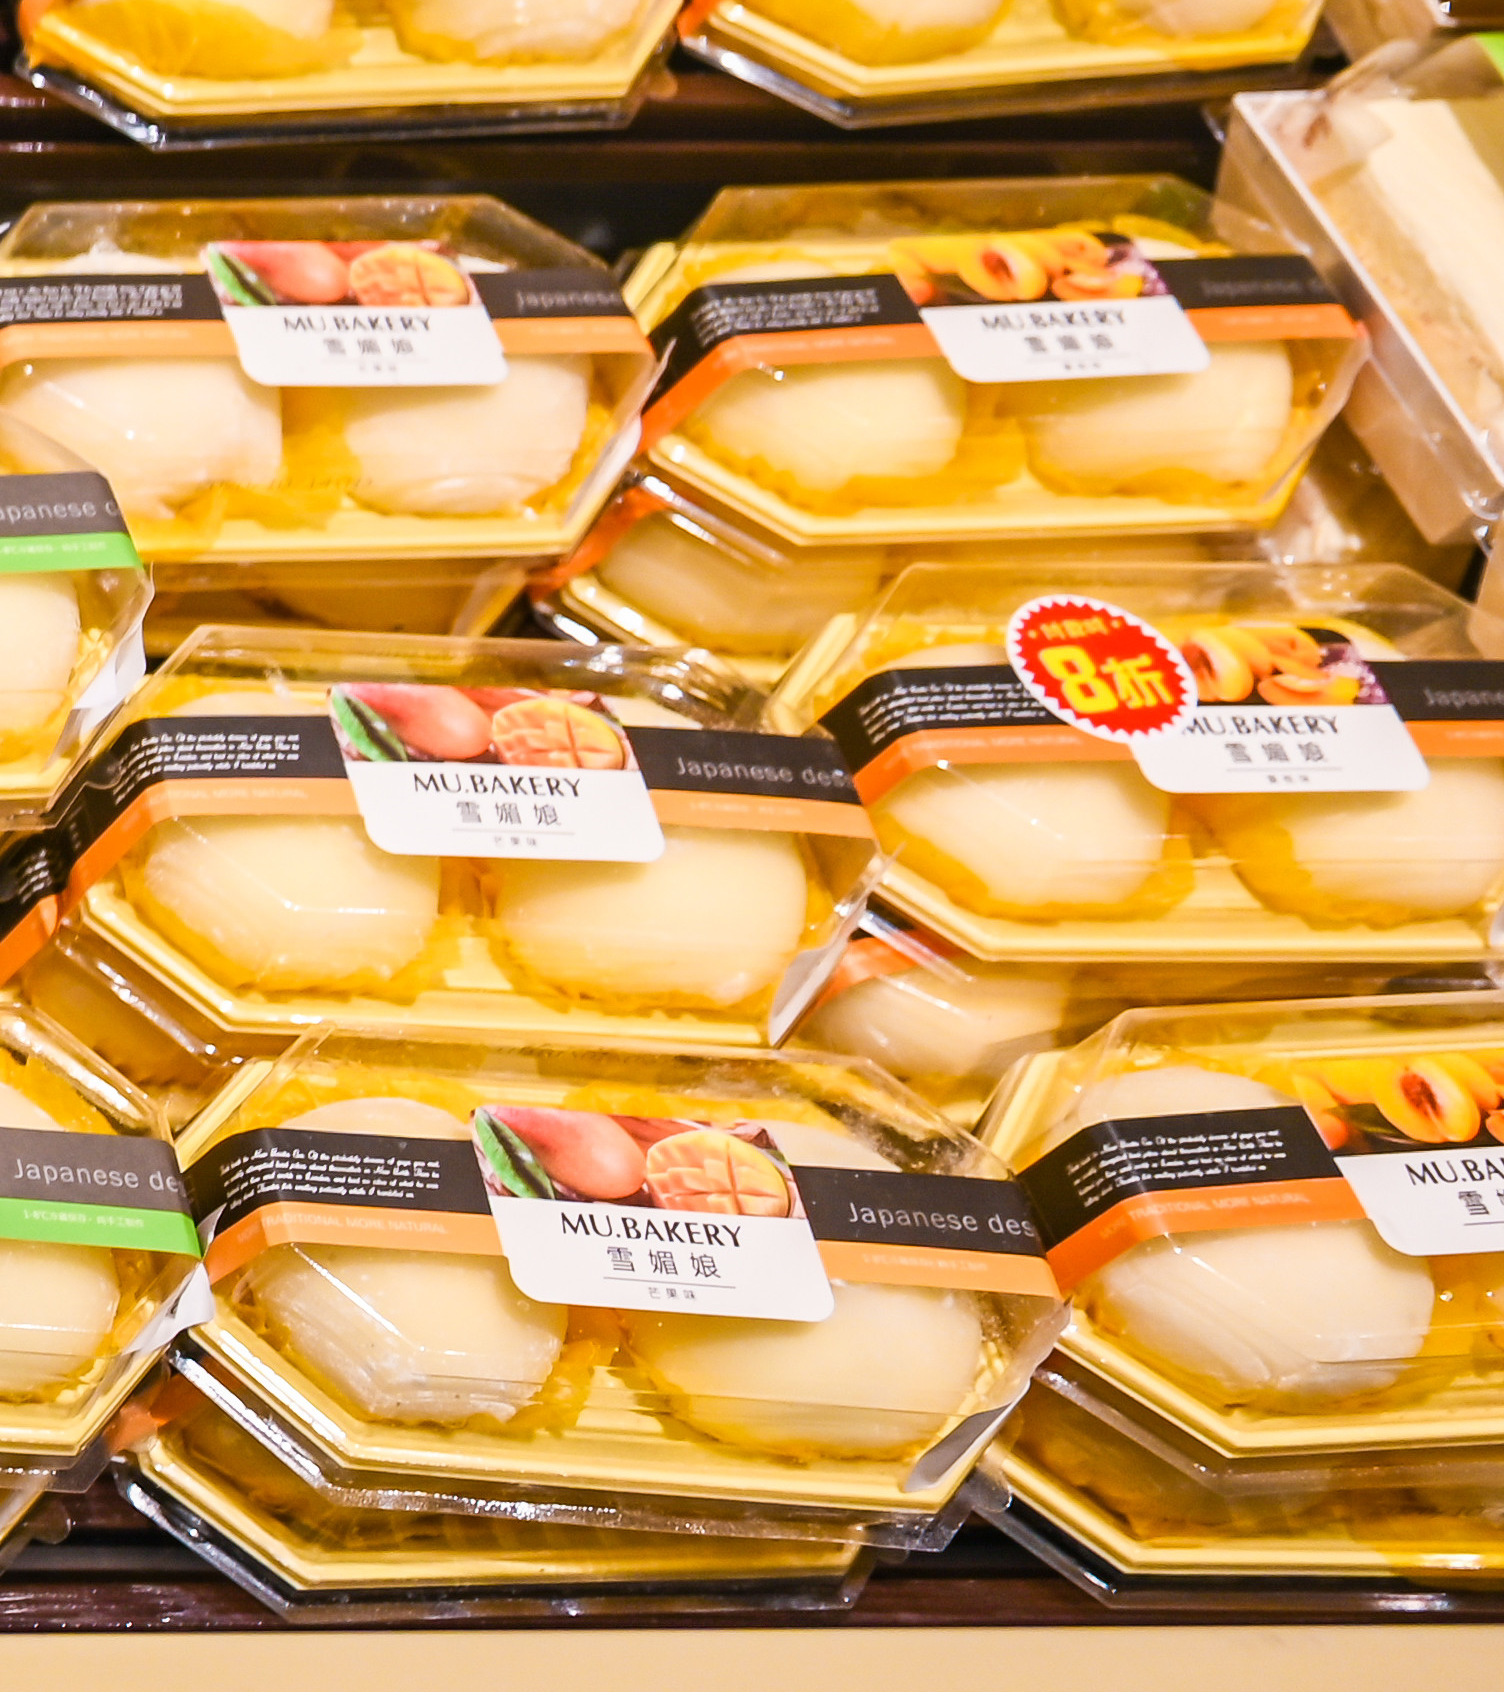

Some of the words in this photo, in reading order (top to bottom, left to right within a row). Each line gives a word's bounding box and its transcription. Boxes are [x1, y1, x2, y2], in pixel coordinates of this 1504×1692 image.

[282, 314, 433, 335] MU.BAKERY
[980, 308, 1128, 332] MU.BAKERY
[1038, 644, 1175, 715] 8折
[1181, 716, 1341, 737] MU.BAKERY
[674, 754, 796, 784] Japanese
[413, 770, 582, 799] MU.BAKERY
[455, 799, 564, 828] 雪媚娘
[13, 1158, 140, 1189] Japanese
[1405, 1157, 1504, 1187] MU.BA
[561, 1209, 744, 1248] MU.BAKERY
[848, 1199, 980, 1238] Japanese
[606, 1244, 724, 1282] 雪媚娘
